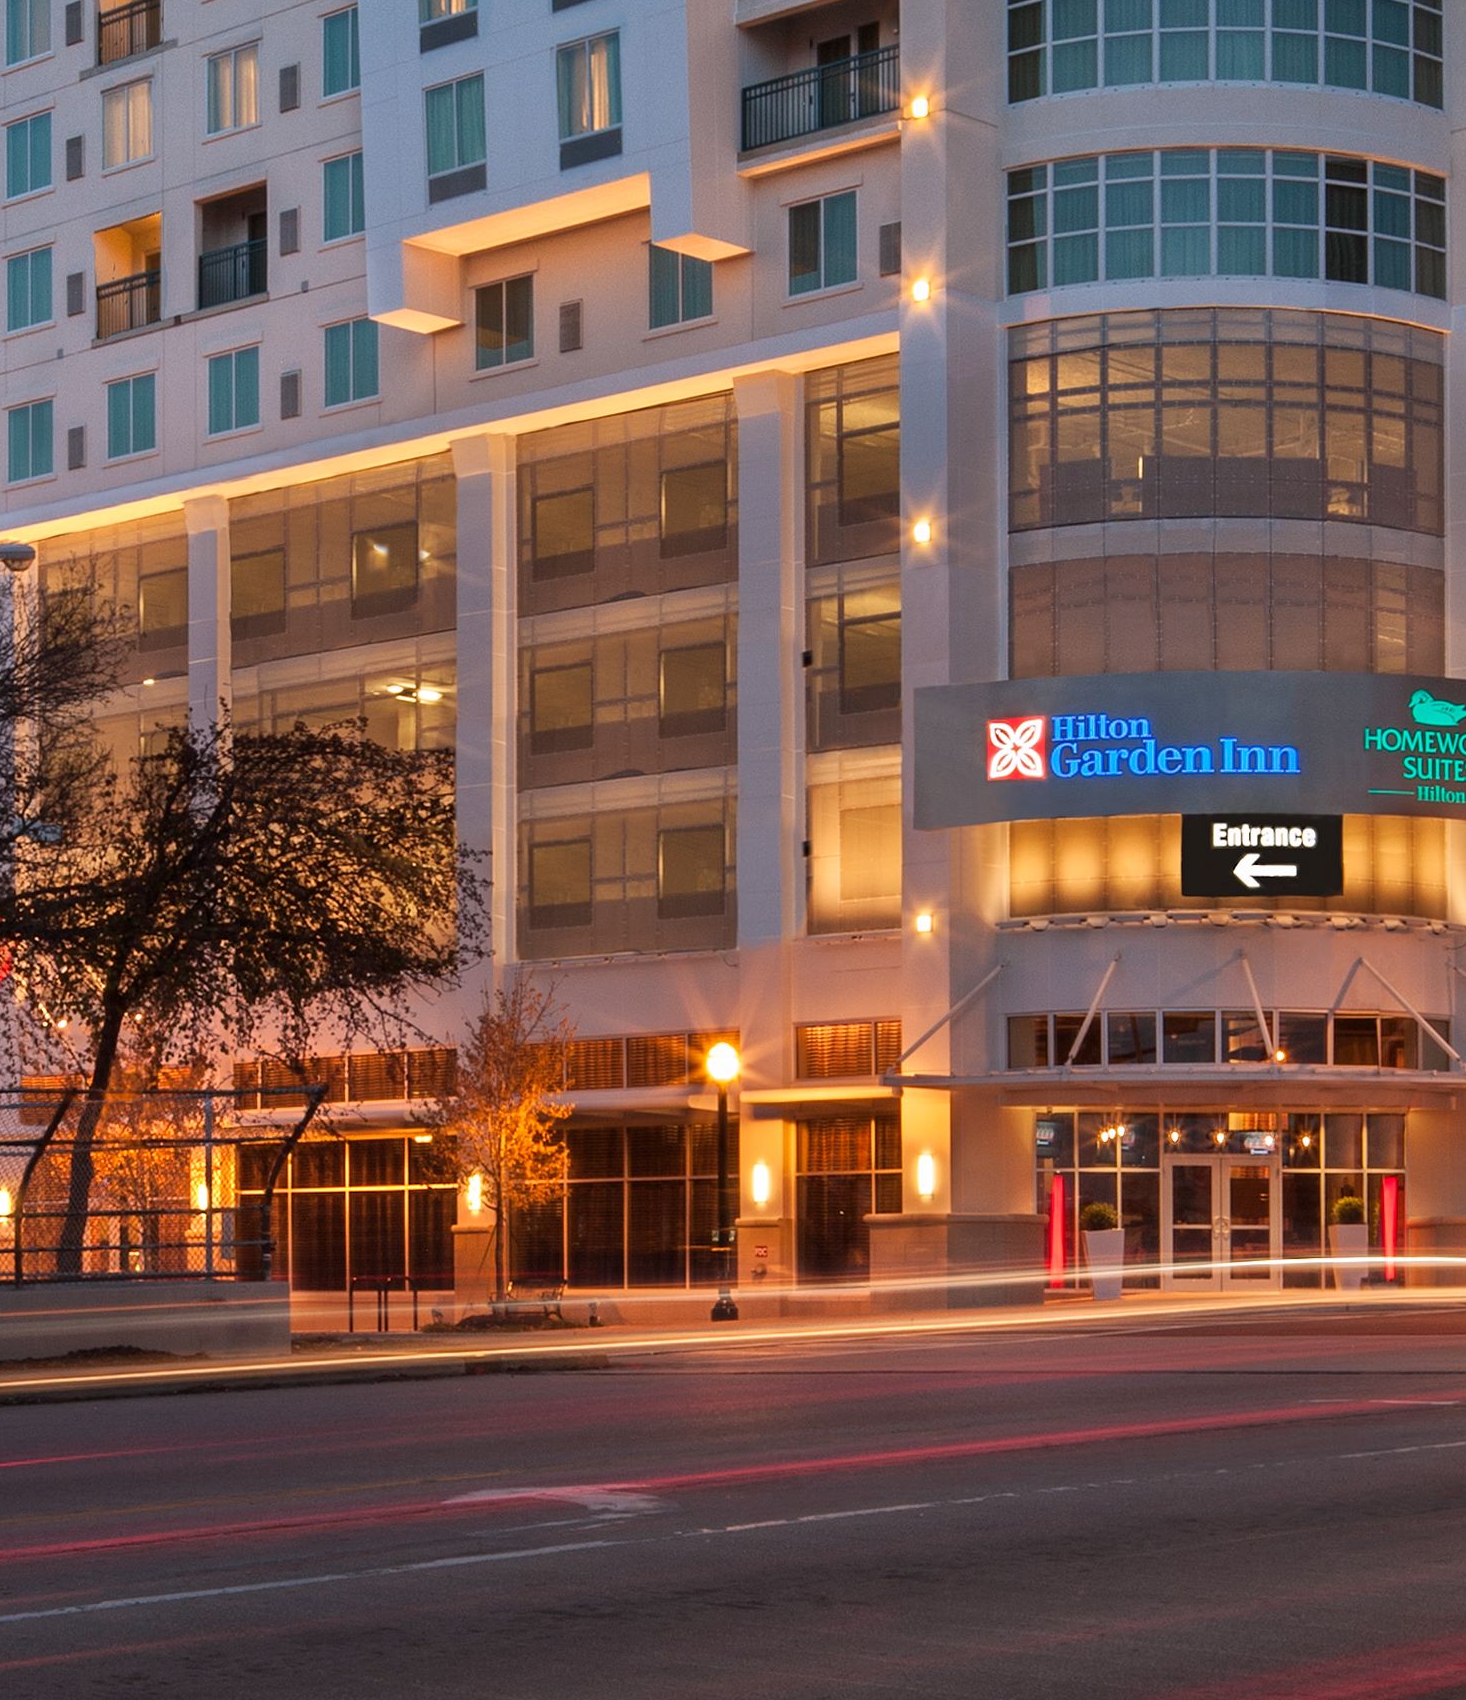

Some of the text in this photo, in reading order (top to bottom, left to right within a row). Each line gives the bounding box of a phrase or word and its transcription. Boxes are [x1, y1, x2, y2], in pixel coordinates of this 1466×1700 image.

[1051, 714, 1152, 742] Hilton
[1050, 736, 1302, 779] Garden Inn
[1416, 784, 1466, 804] Hilton
[1212, 822, 1317, 848] Entrance
